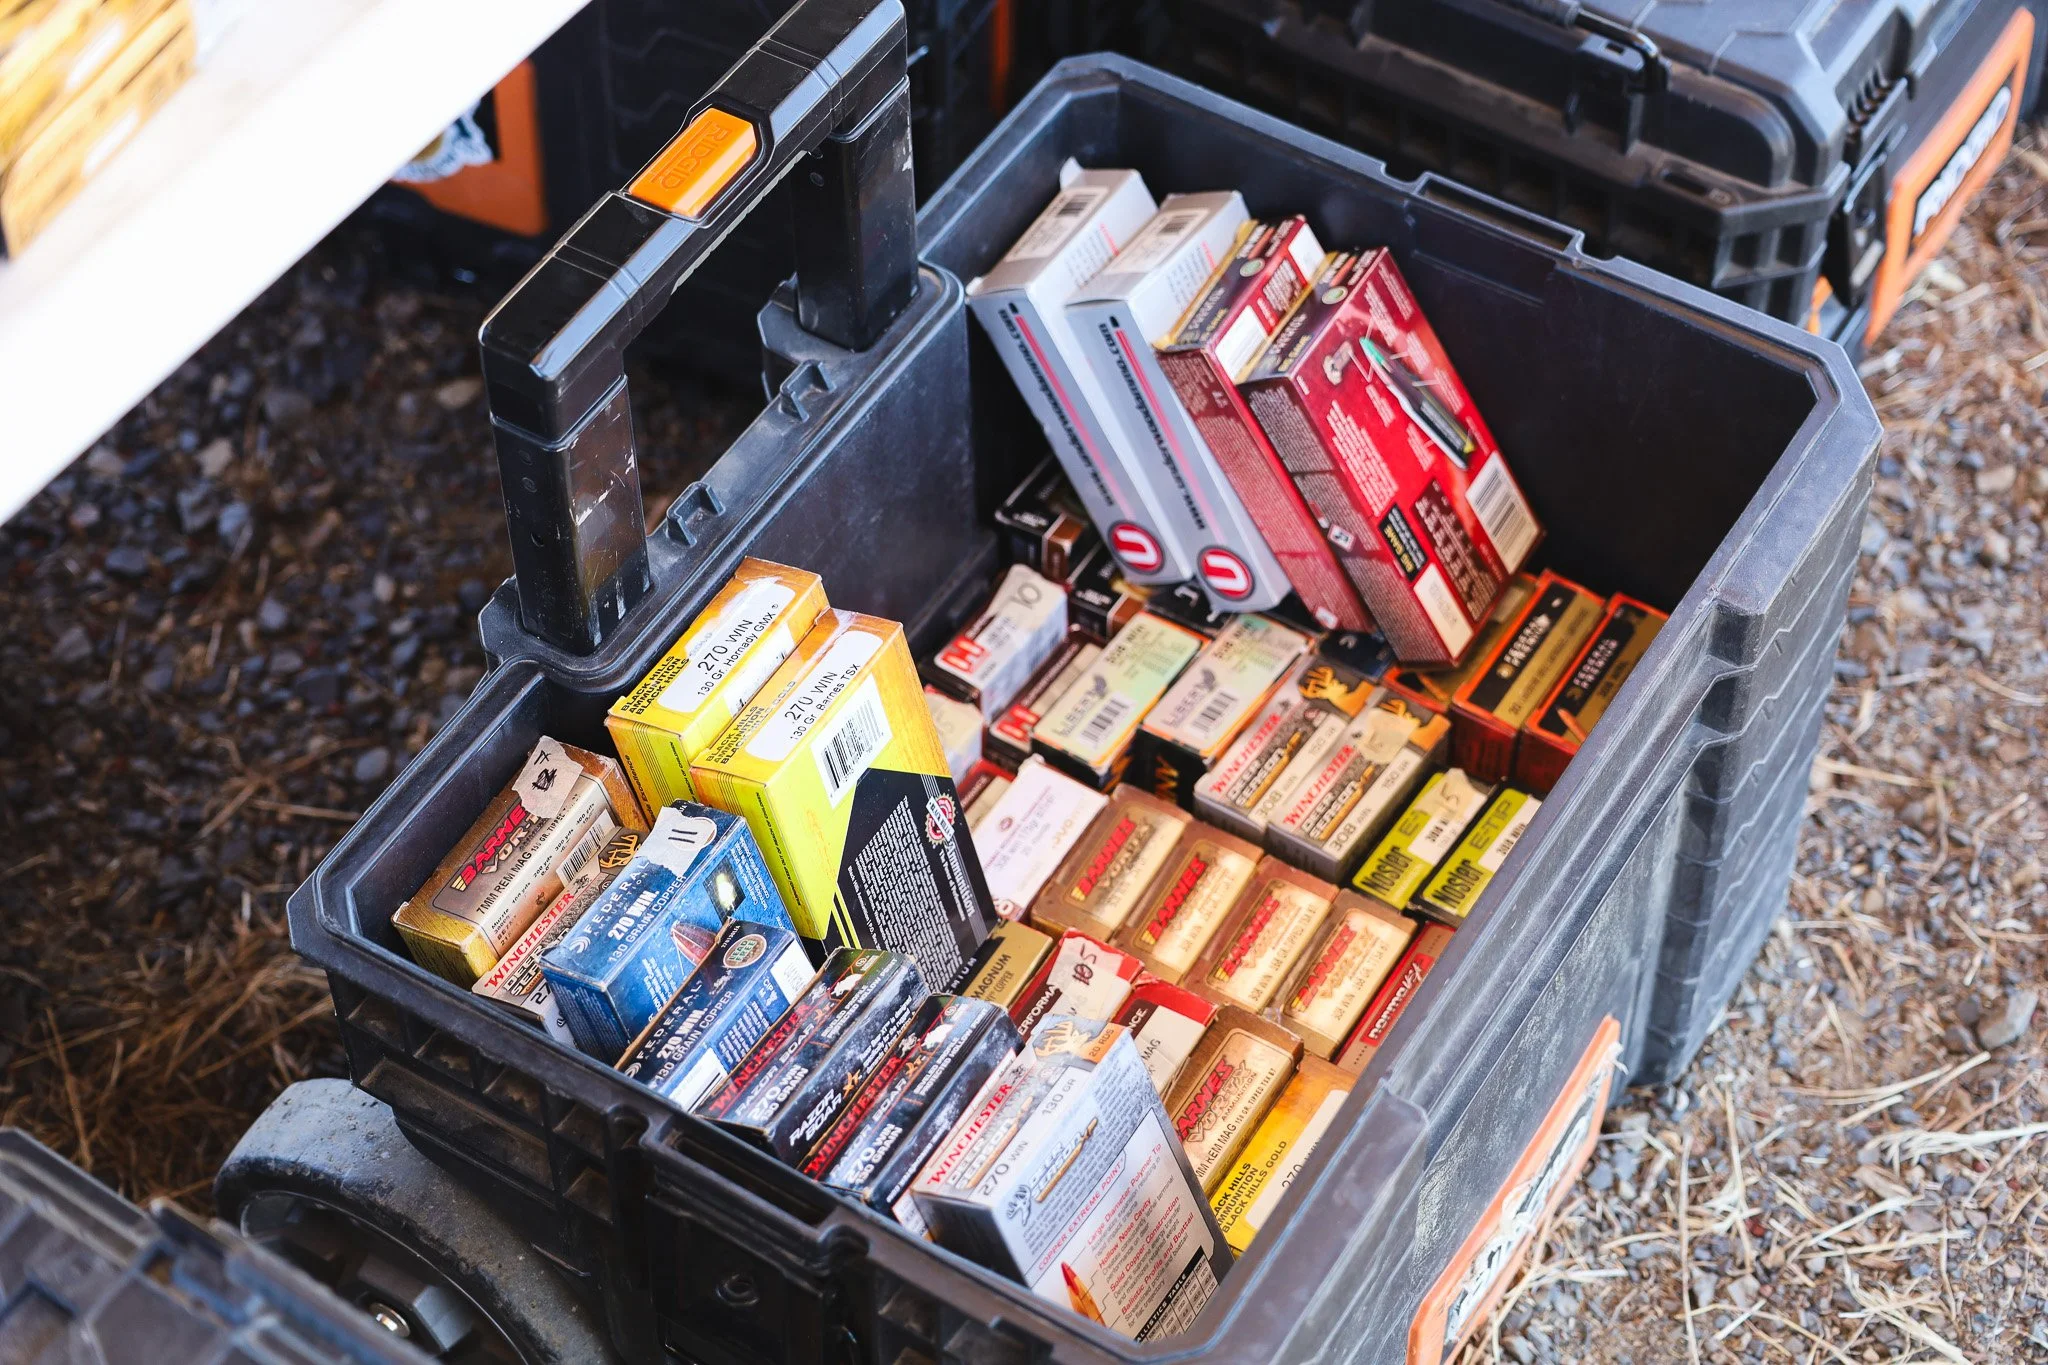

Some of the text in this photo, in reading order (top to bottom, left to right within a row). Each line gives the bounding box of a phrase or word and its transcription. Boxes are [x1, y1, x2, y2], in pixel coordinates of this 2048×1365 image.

[695, 616, 753, 675] .270 WIN
[696, 609, 775, 698] 130 Gr. Hornady GMX
[620, 653, 675, 713] BLACK HILLS
[628, 655, 681, 715] AMMUNITION
[635, 655, 690, 716] BLACK HILLS
[809, 668, 838, 697] WIN
[815, 680, 845, 712] Barnes
[839, 661, 861, 683] TSX
[705, 704, 759, 763] BLACK HILLS
[712, 705, 765, 765] AMMUNITION
[1209, 709, 1283, 797] WINCHESTER
[624, 754, 648, 803] Excellence
[1255, 789, 1283, 819] 308
[1282, 742, 1355, 828] WINCHESTER
[457, 802, 528, 887] BARNE
[1077, 814, 1137, 896] BARNES
[1329, 822, 1357, 852] 308
[476, 891, 499, 916] 7MM
[494, 870, 516, 894] REM
[511, 849, 533, 874] MAG
[582, 858, 650, 934] FEDERAL
[943, 839, 978, 917] Ammunition
[1146, 854, 1209, 940] BARNES
[1360, 842, 1414, 899] Nosler
[1430, 855, 1484, 912] Nosler
[484, 892, 575, 988] WINCHESTER
[607, 884, 659, 942] 270 WIN.
[608, 872, 687, 963] 130 GRAIN COPPER
[970, 951, 1011, 1000] MAGNUM
[1295, 923, 1358, 1007] BARNES
[635, 981, 702, 1061] FEDERAL
[654, 1059, 675, 1082] 130
[671, 1027, 702, 1062] GRAIN
[698, 988, 735, 1030] COPPER
[656, 1031, 684, 1062] 270
[678, 1002, 708, 1036] WIN.
[1018, 982, 1057, 1035] ERFORMA
[708, 1000, 810, 1115] WINCHESTER
[777, 1021, 815, 1064] BOAR
[1088, 1026, 1115, 1058] 20 RDS
[776, 1065, 809, 1102] GRAIN
[778, 1063, 801, 1087] WIN
[871, 1076, 908, 1121] BOAR
[1168, 1057, 1235, 1141] ARNES
[1220, 1071, 1257, 1121] AMMUNITION
[786, 1086, 838, 1146] RAZOR
[802, 1053, 902, 1178] WINCHESTER
[802, 1091, 845, 1140] BOAR
[871, 1124, 903, 1164] GRAIN
[926, 1081, 1012, 1189] WINCHESTER
[978, 1076, 1076, 1199] 270 WIN 130 GR
[1203, 1140, 1223, 1164] REM
[1217, 1121, 1238, 1145] MAG
[842, 1121, 896, 1184] 270 WIN
[1085, 1142, 1164, 1245] Large Diameter Polymer Tip
[1209, 1161, 1252, 1217] LACK HILLS
[1220, 1139, 1288, 1233] BLACK HILLS GOLD
[1036, 1229, 1069, 1270] COPPER
[1067, 1190, 1102, 1233] EXTREME
[1096, 1196, 1154, 1268] Hollow Nose Cavity
[1107, 1195, 1181, 1292] Solid Copper Construction
[1119, 1212, 1196, 1314] Ballistic Profile and Boattail
[1166, 1273, 1187, 1301] TABLE
